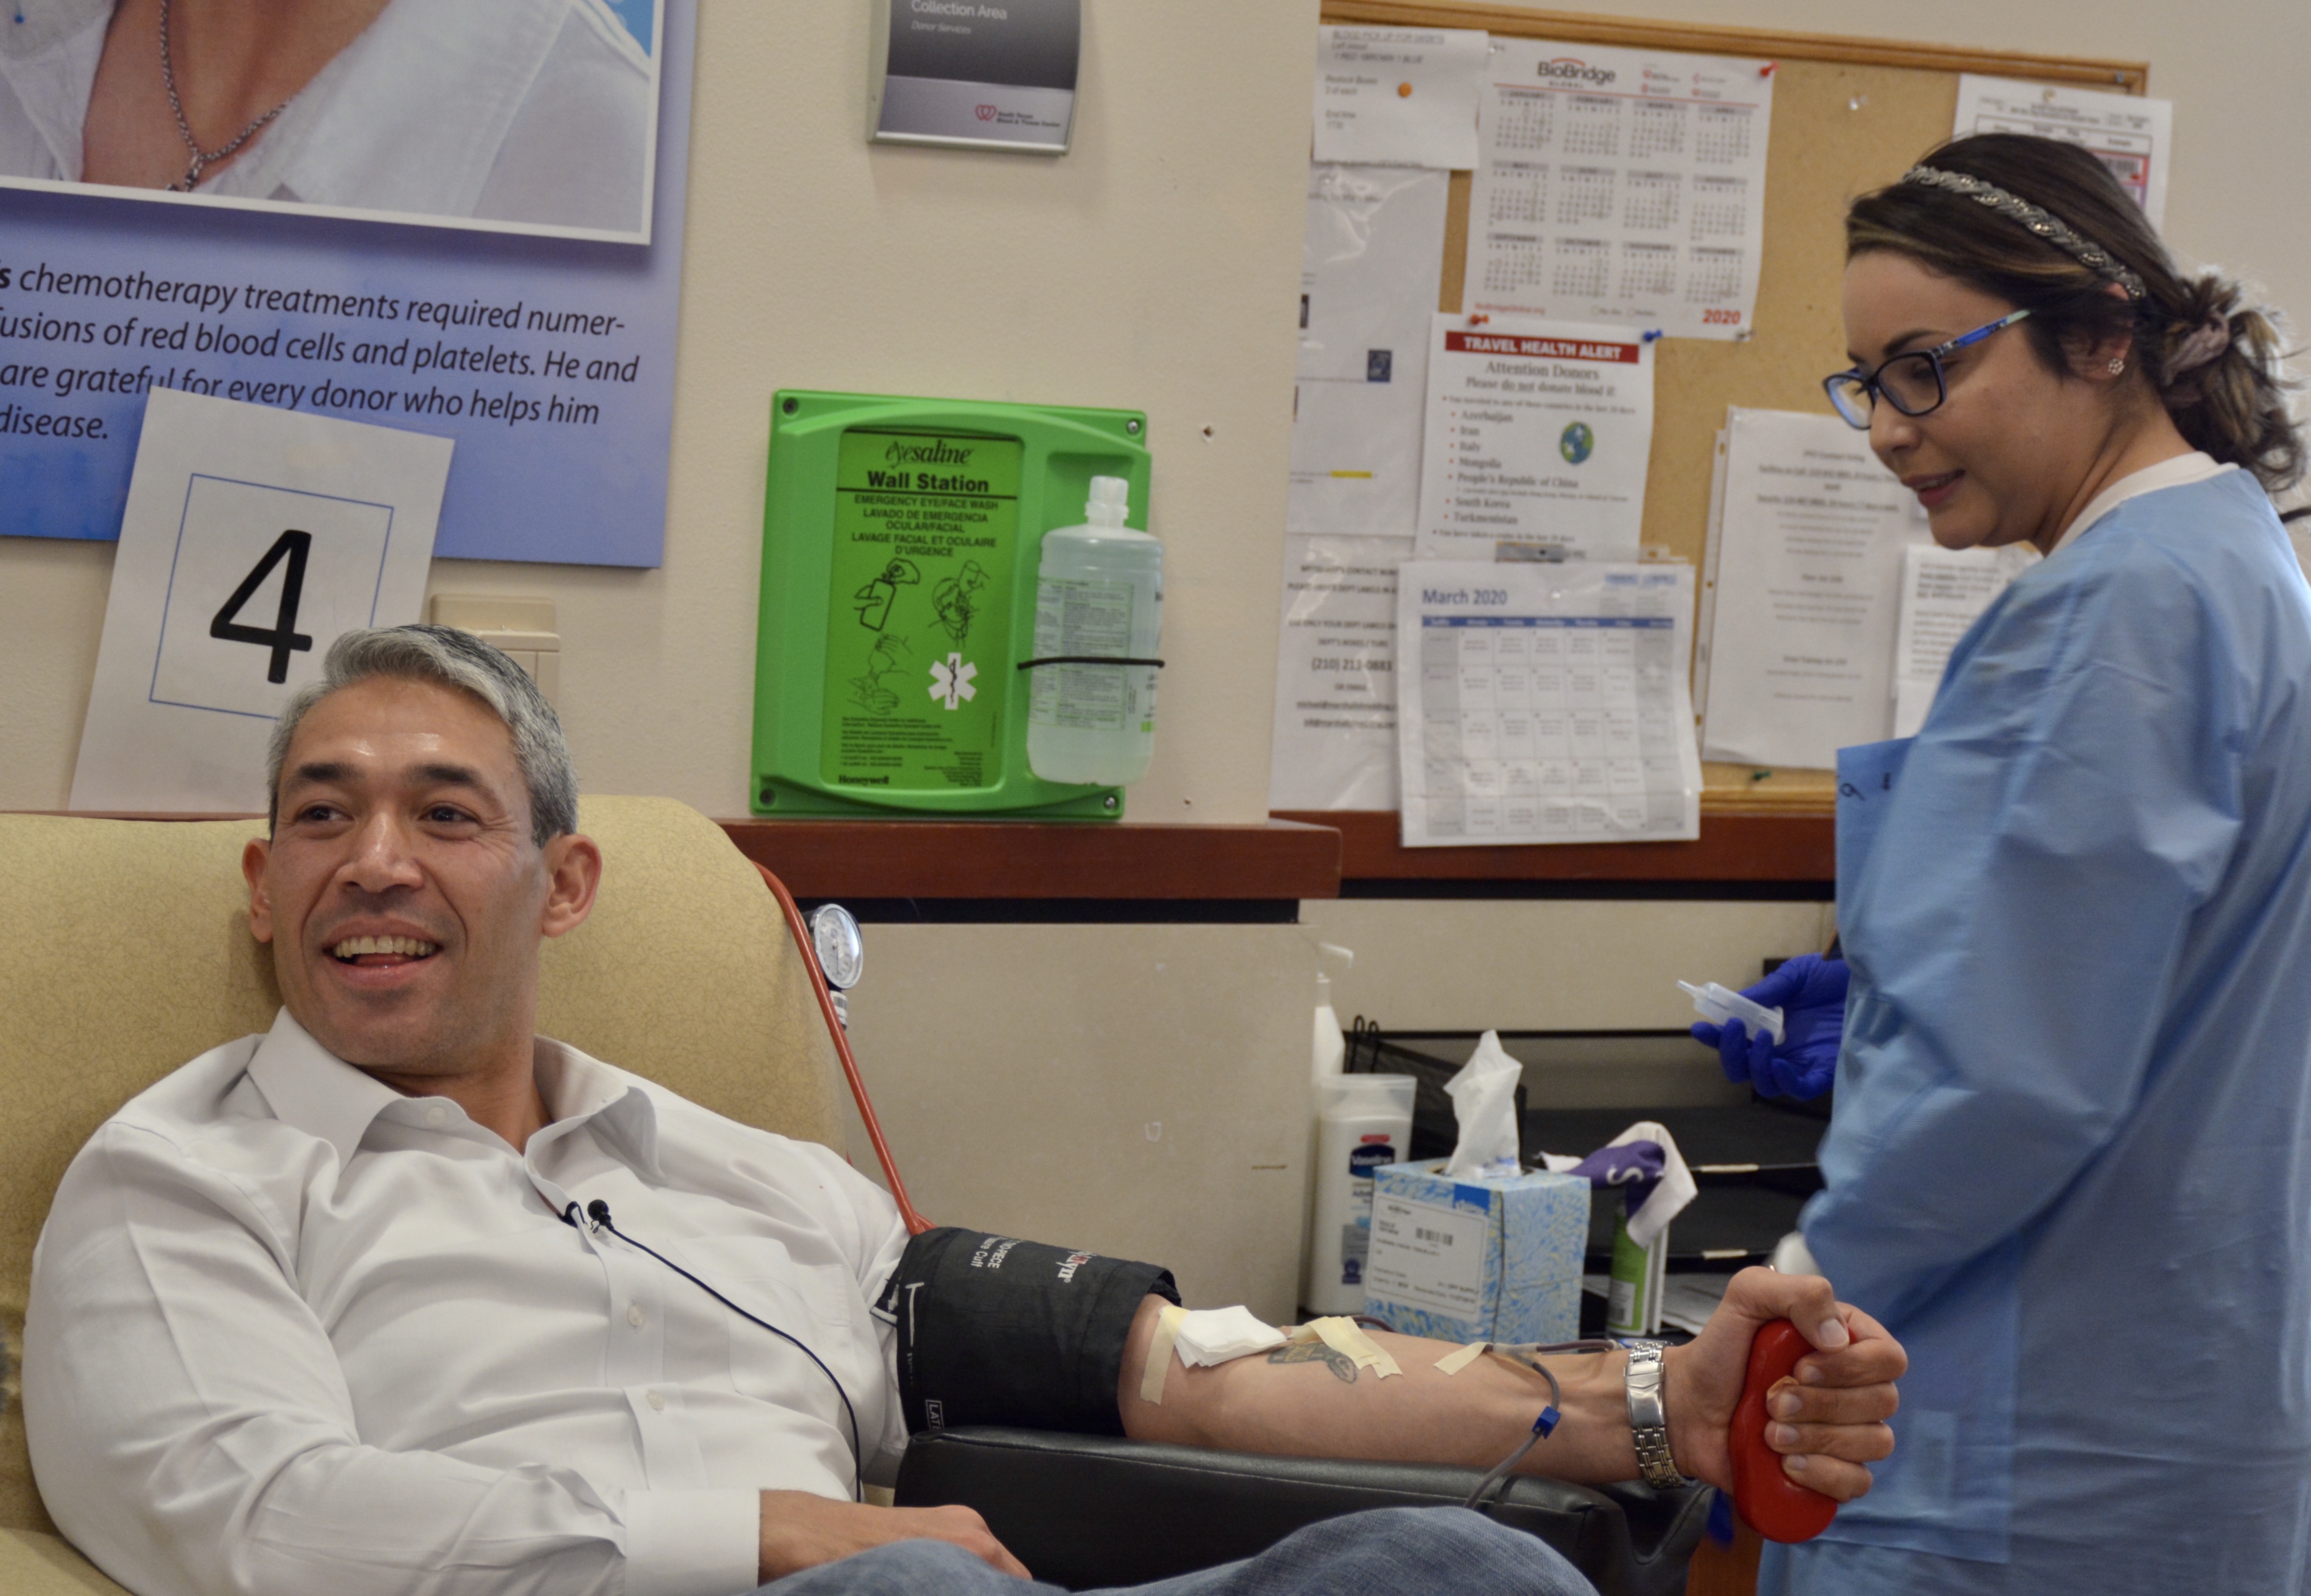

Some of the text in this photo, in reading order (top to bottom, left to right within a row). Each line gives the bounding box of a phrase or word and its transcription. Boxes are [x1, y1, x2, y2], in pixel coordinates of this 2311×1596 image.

[910, 0, 1008, 20] Collection Area
[911, 20, 936, 32] Donor
[1538, 60, 1616, 86] BioBridge
[0, 262, 625, 336] s chemotherapy treatments required numer-
[1702, 308, 1742, 325] 2020
[104, 317, 138, 346] of
[140, 322, 189, 350] red
[194, 322, 280, 357] blood
[286, 330, 345, 361] cells
[352, 338, 409, 366] and
[412, 340, 536, 376] platelets.
[543, 350, 580, 378] He
[586, 355, 640, 382] and
[1463, 336, 1623, 360] TRAVEL HEALTH ALERT
[1485, 361, 1600, 380] Attention Donors
[0, 363, 48, 388] are
[228, 378, 306, 411] every
[311, 378, 398, 412] donor
[404, 386, 463, 416] who
[469, 388, 541, 426] helps
[547, 394, 600, 424] him
[1466, 377, 1498, 390] Please
[1501, 378, 1515, 392] do
[1517, 380, 1535, 392] not
[1538, 381, 1572, 394] donate
[1575, 384, 1604, 396] blood
[0, 404, 108, 440] disease.
[1460, 410, 1514, 424] Azerbaijan
[1459, 426, 1480, 436] Iran
[1458, 442, 1480, 454] Italy
[1459, 457, 1502, 470] Mongolia
[867, 470, 990, 492] Wall Station
[1456, 473, 1497, 486] People's
[1499, 476, 1536, 488] Republic
[1552, 477, 1580, 488] China
[854, 494, 917, 506] EMERGENCY
[970, 500, 999, 510] WASH
[1454, 497, 1511, 509] South Korea
[863, 508, 988, 522] LAVADO DE EMERGENCIA
[886, 520, 966, 533] OCULAR/FACIAL
[852, 532, 996, 548] LAVAGE FACIAL ET OCULAIRE
[894, 545, 954, 557] D'URGENCE
[1422, 588, 1508, 606] March 2020
[210, 529, 312, 684] 4
[1312, 656, 1340, 672] (210)
[838, 775, 890, 786] Honeywell
[970, 1251, 988, 1268] Cuff
